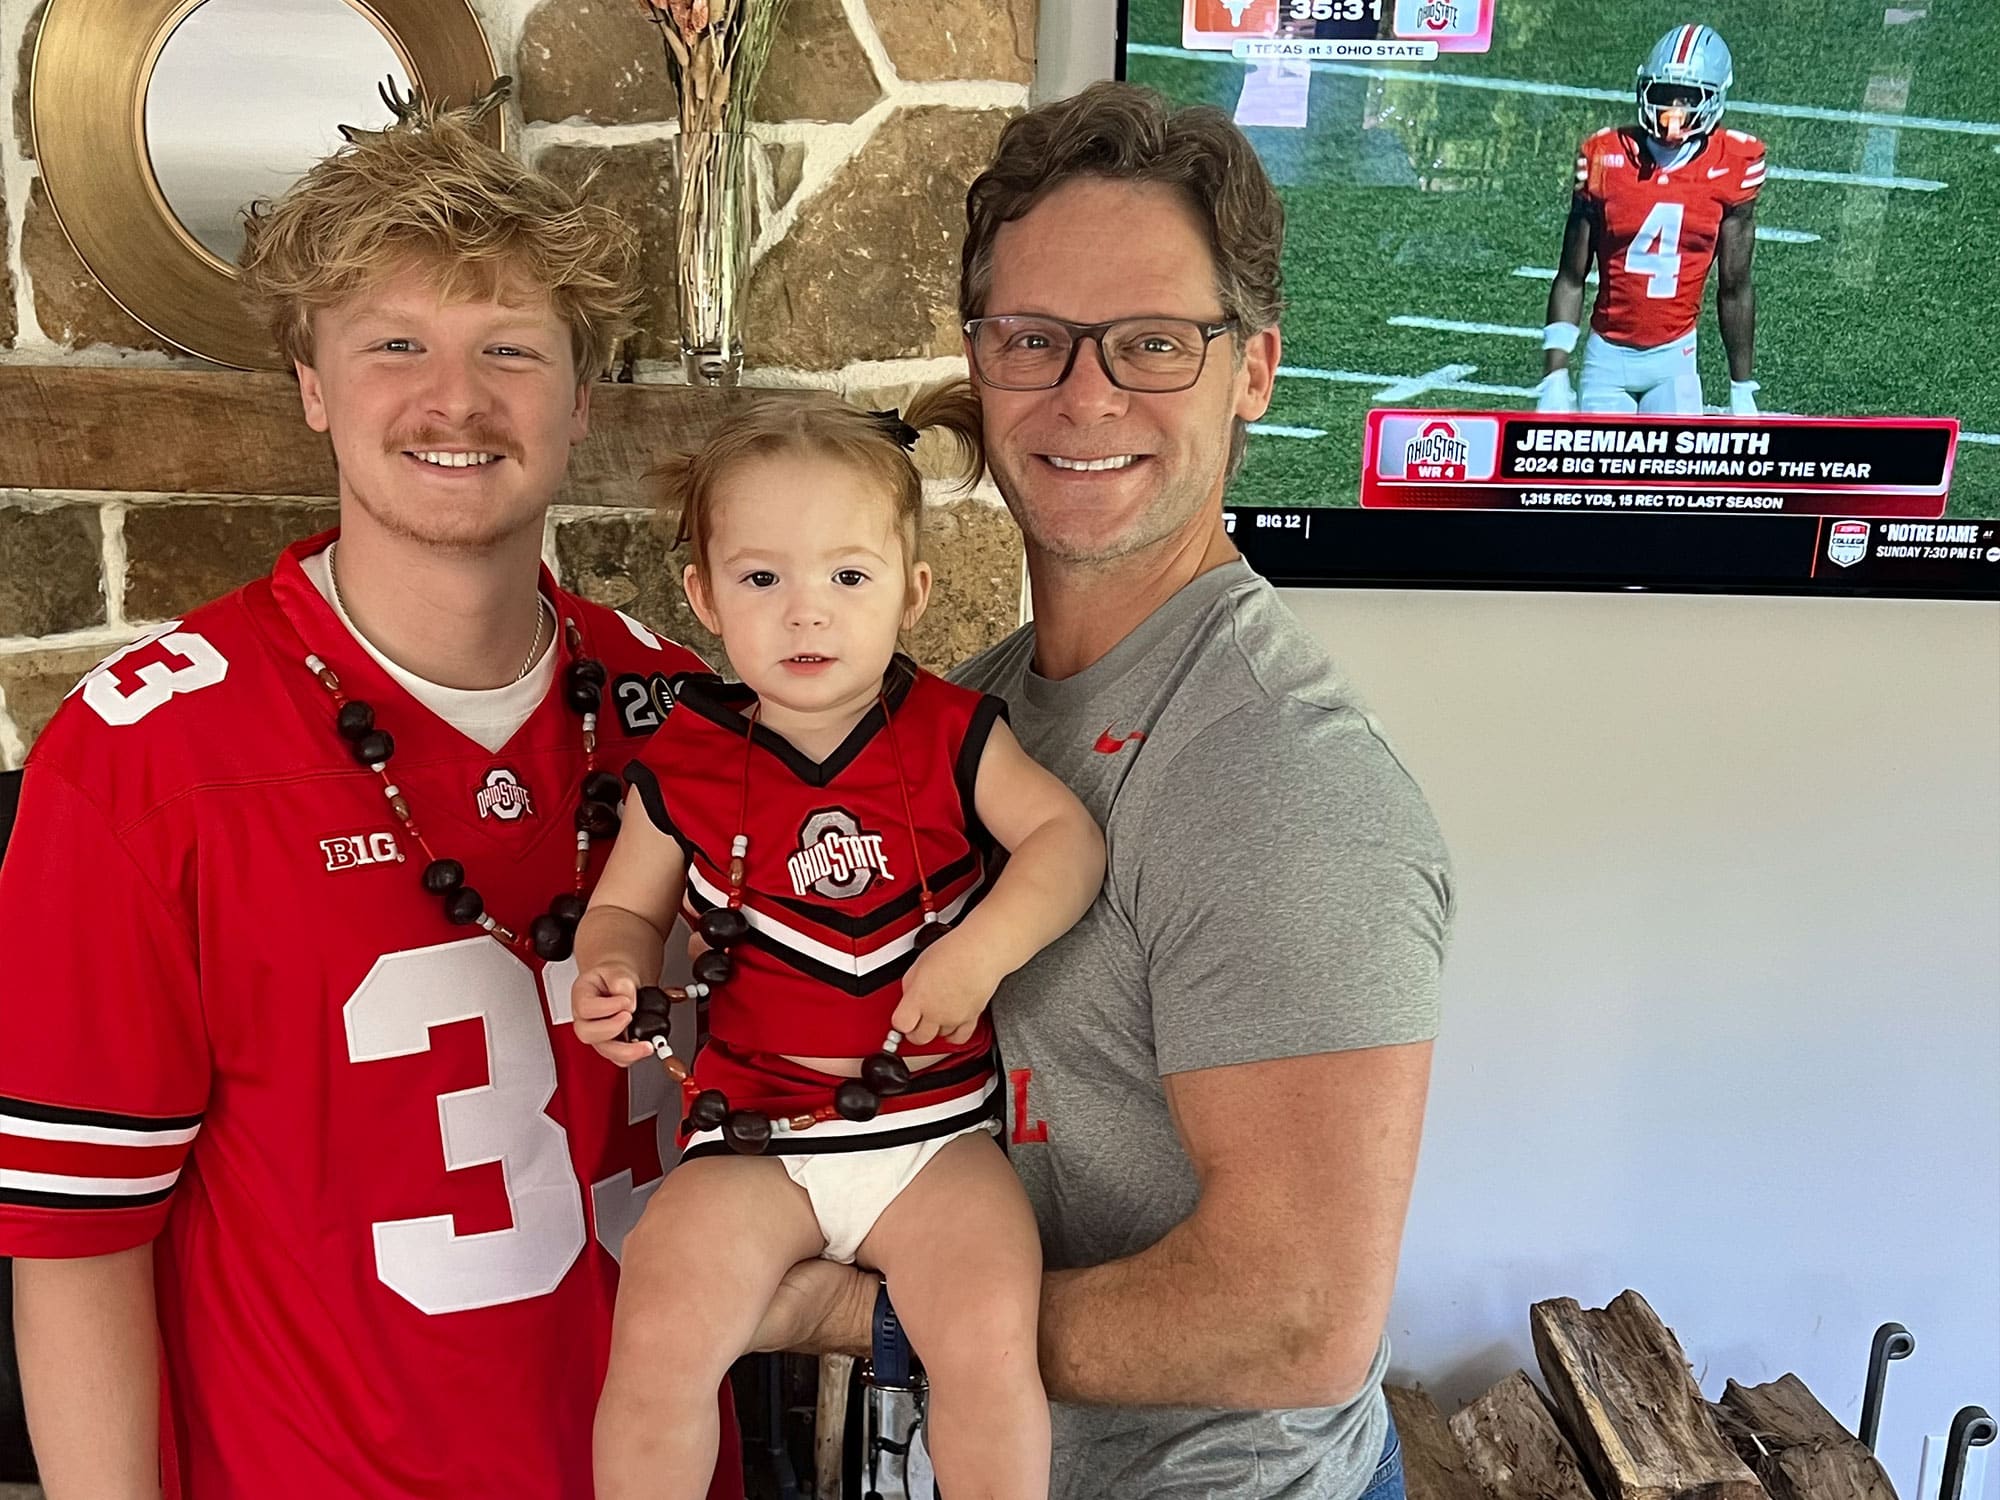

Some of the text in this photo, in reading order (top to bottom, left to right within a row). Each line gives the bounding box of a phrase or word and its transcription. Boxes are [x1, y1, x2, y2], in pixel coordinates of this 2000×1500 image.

[1290, 0, 1381, 20] 35:31
[1255, 44, 1303, 54] TEXAS
[1308, 46, 1321, 55] at
[1326, 45, 1333, 55] 3
[1336, 45, 1372, 56] OHIO
[1377, 46, 1424, 56] STATE
[1624, 202, 1685, 299] 4
[1407, 435, 1467, 465] OHIO STATE
[1516, 429, 1770, 455] JEREMIAH SMITH
[1418, 466, 1454, 478] WR 4
[1514, 457, 1871, 478] 2024 BIG TEN FRESHMAN OF THE YEAR
[1520, 493, 1783, 509] 1,315 REC YDS, 15 REC TD LAST SEASON
[1256, 514, 1300, 528] BIG 12
[1887, 523, 1937, 543] NOTRE
[1936, 525, 1979, 543] DAME
[1876, 546, 1921, 559] SUNDAY
[1923, 547, 1949, 559] 7:30
[1950, 547, 1969, 559] PM
[1969, 547, 1984, 559] ET
[476, 781, 533, 818] OHIO STATE
[788, 832, 895, 896] OHIO STATE
